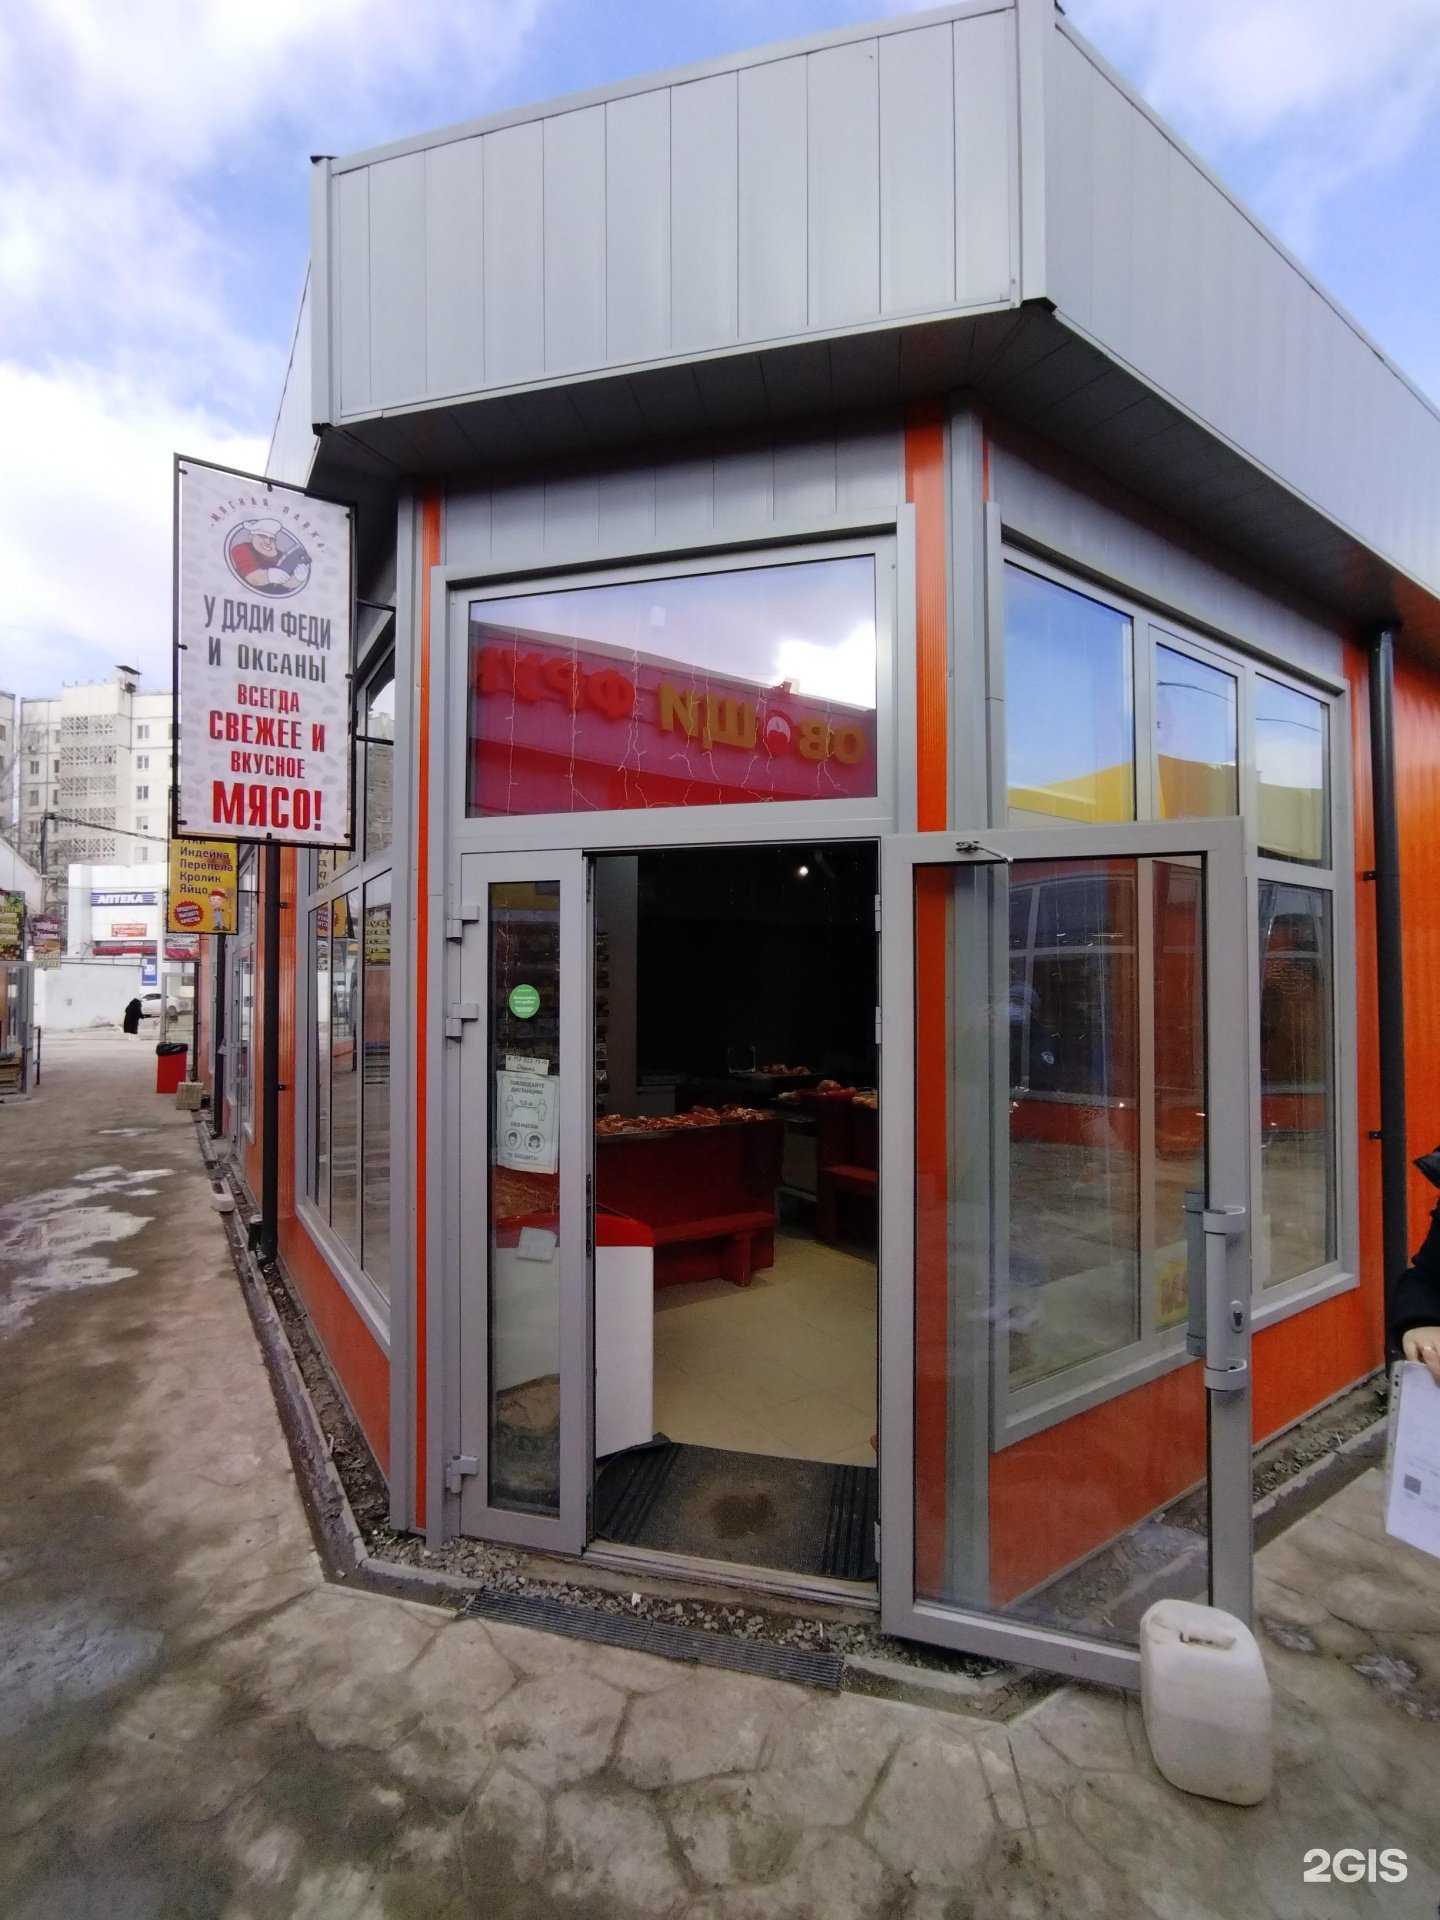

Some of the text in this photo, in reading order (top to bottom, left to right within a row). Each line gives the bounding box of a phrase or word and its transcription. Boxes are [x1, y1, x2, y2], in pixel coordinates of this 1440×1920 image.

[203, 594, 331, 650] У ДЯДИ ФЕДИ
[208, 636, 326, 684] И ОКСАНЫ
[237, 683, 300, 715] ВСЕГДА
[209, 710, 325, 752] СВЕЖЕЕ И
[231, 750, 305, 779] ВКУСНОЕ
[212, 780, 322, 832] МЯСО!
[97, 894, 143, 904] АПТЕКА
